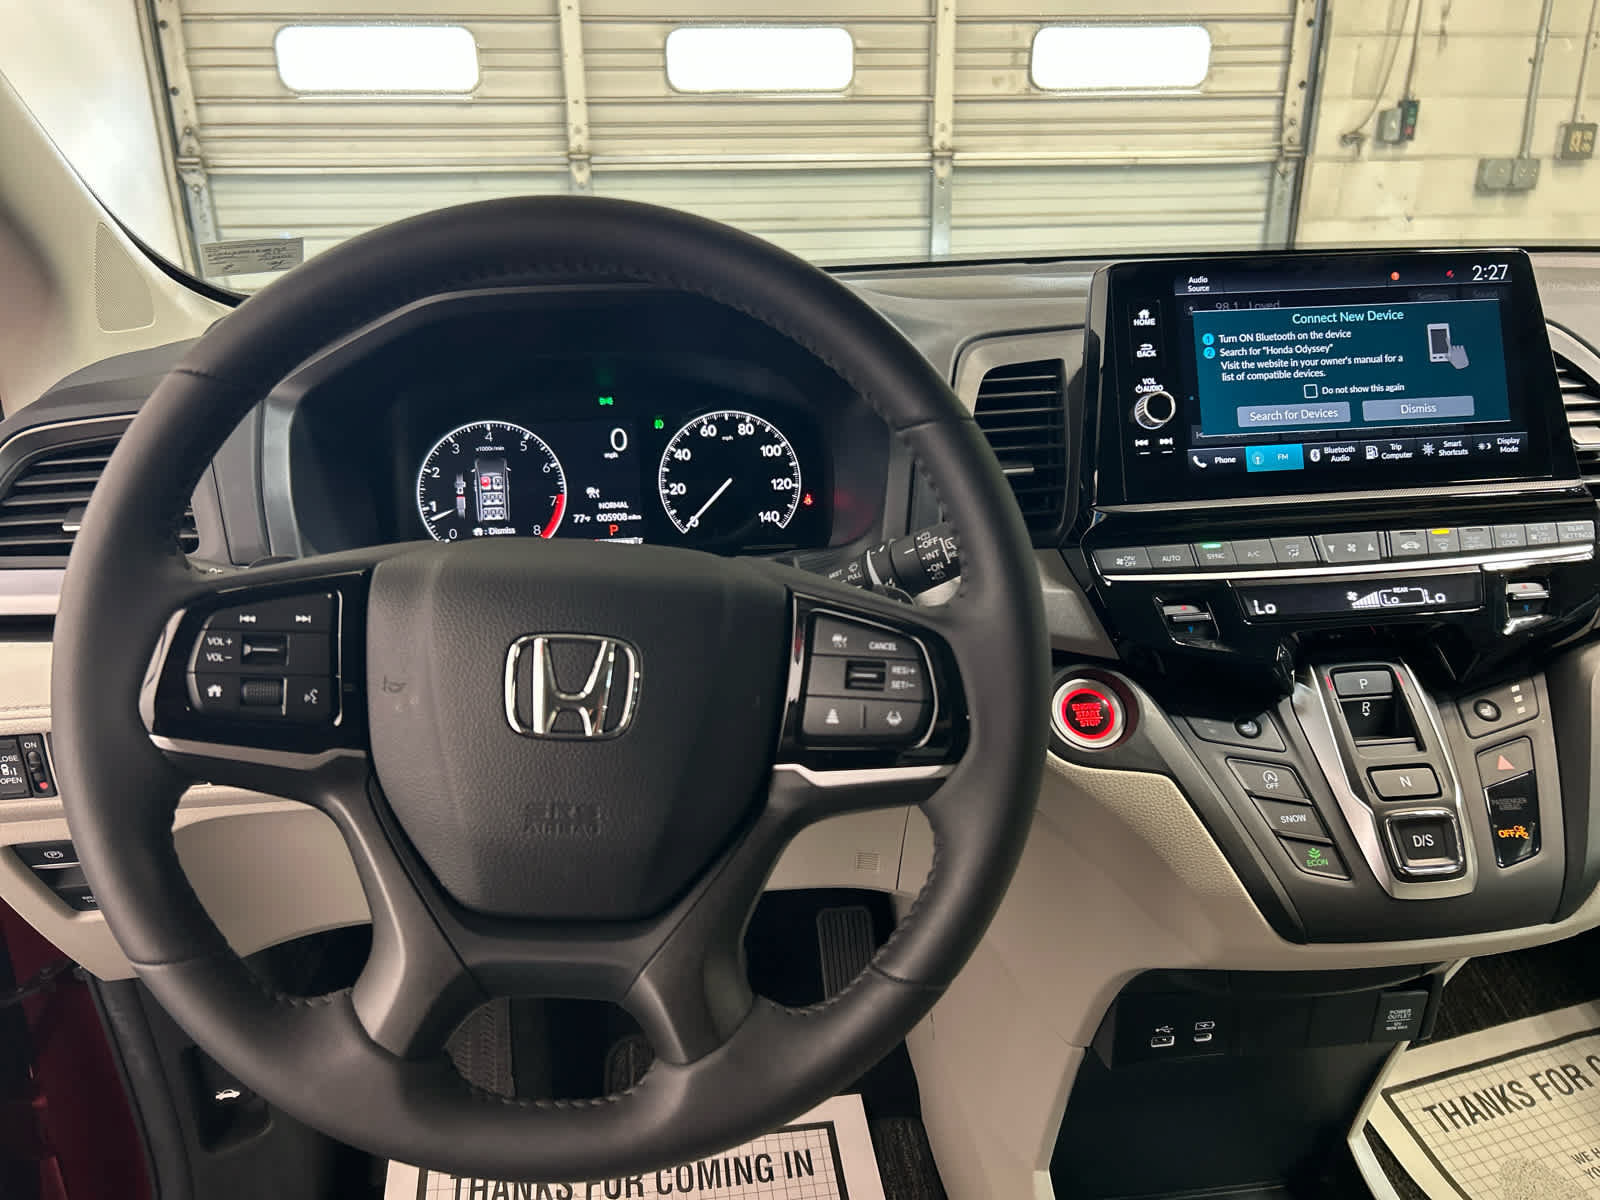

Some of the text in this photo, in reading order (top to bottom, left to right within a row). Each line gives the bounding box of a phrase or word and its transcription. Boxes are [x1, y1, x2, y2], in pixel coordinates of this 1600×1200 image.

[1472, 265, 1508, 280] 2:27
[1188, 276, 1208, 284] Audio
[1133, 318, 1156, 326] HOME
[1292, 310, 1404, 324] Connect New Device
[1218, 334, 1237, 343] Turn
[1239, 333, 1254, 342] ON
[1256, 332, 1295, 342] Bluetooth
[1310, 331, 1324, 339] the
[1325, 330, 1352, 339] device
[1136, 349, 1157, 358] BACK
[1219, 344, 1334, 357] Search for "Honda Odyssey"
[1221, 360, 1241, 370] Visit
[1243, 360, 1257, 369] the
[1258, 358, 1289, 368] website
[1290, 358, 1299, 367] in
[1300, 359, 1319, 369] your
[1320, 356, 1352, 365] owner's
[1353, 355, 1383, 364] manual
[1384, 354, 1397, 363] for
[1222, 368, 1327, 381] list of compatible devices.
[1143, 384, 1164, 392] AUDIO
[1322, 383, 1405, 395] Do not show this again
[1400, 404, 1437, 414] Dismiss
[1250, 409, 1338, 422] Search for Devices
[700, 424, 717, 437] 60
[738, 423, 755, 435] 80
[485, 432, 493, 442] 4
[611, 428, 628, 451] 0
[1497, 437, 1521, 446] Display
[452, 444, 460, 454] 3
[520, 441, 528, 451] 5
[1390, 443, 1402, 451] Trip
[1443, 440, 1462, 448] Smart
[760, 445, 782, 457] 100
[1324, 446, 1356, 454] Bluetooth
[1438, 448, 1470, 457] Shortcuts
[1500, 445, 1519, 454] Mode
[604, 452, 619, 460] mph
[674, 449, 691, 461] 40
[1214, 456, 1237, 464] Phone
[1277, 453, 1289, 461] FM
[1331, 454, 1351, 462] Audio
[1381, 451, 1413, 460] Computer
[431, 467, 440, 478] 2
[543, 463, 551, 473] 6
[670, 483, 686, 495] 20
[771, 479, 793, 490] 120
[550, 496, 557, 506] 7
[429, 501, 436, 512] 1
[596, 512, 628, 522] 005908
[758, 511, 780, 523] 140
[449, 529, 457, 539] 0
[489, 527, 516, 535] Dismiss
[533, 525, 541, 535] 8
[609, 524, 619, 536] P
[922, 536, 938, 548] OFF
[925, 550, 940, 561] INT
[1162, 554, 1181, 563] AUTO
[1206, 552, 1225, 561] SYNC
[930, 562, 944, 572] ON
[848, 572, 862, 582] PULL
[207, 637, 224, 646] VOL
[868, 641, 898, 651] CANCEL
[206, 653, 224, 662] VOL
[1359, 679, 1368, 689] P
[1362, 702, 1371, 713] R
[1400, 776, 1412, 788] N
[1280, 815, 1307, 824] SNOW
[1498, 829, 1515, 839] OFF
[1412, 834, 1434, 848] D/S
[1306, 859, 1329, 867] ECON
[1422, 1079, 1537, 1133] THANKS
[1529, 1063, 1595, 1101] FOR
[1570, 1150, 1594, 1165] WE
[655, 1154, 775, 1196] COMING
[784, 1149, 815, 1178] IN
